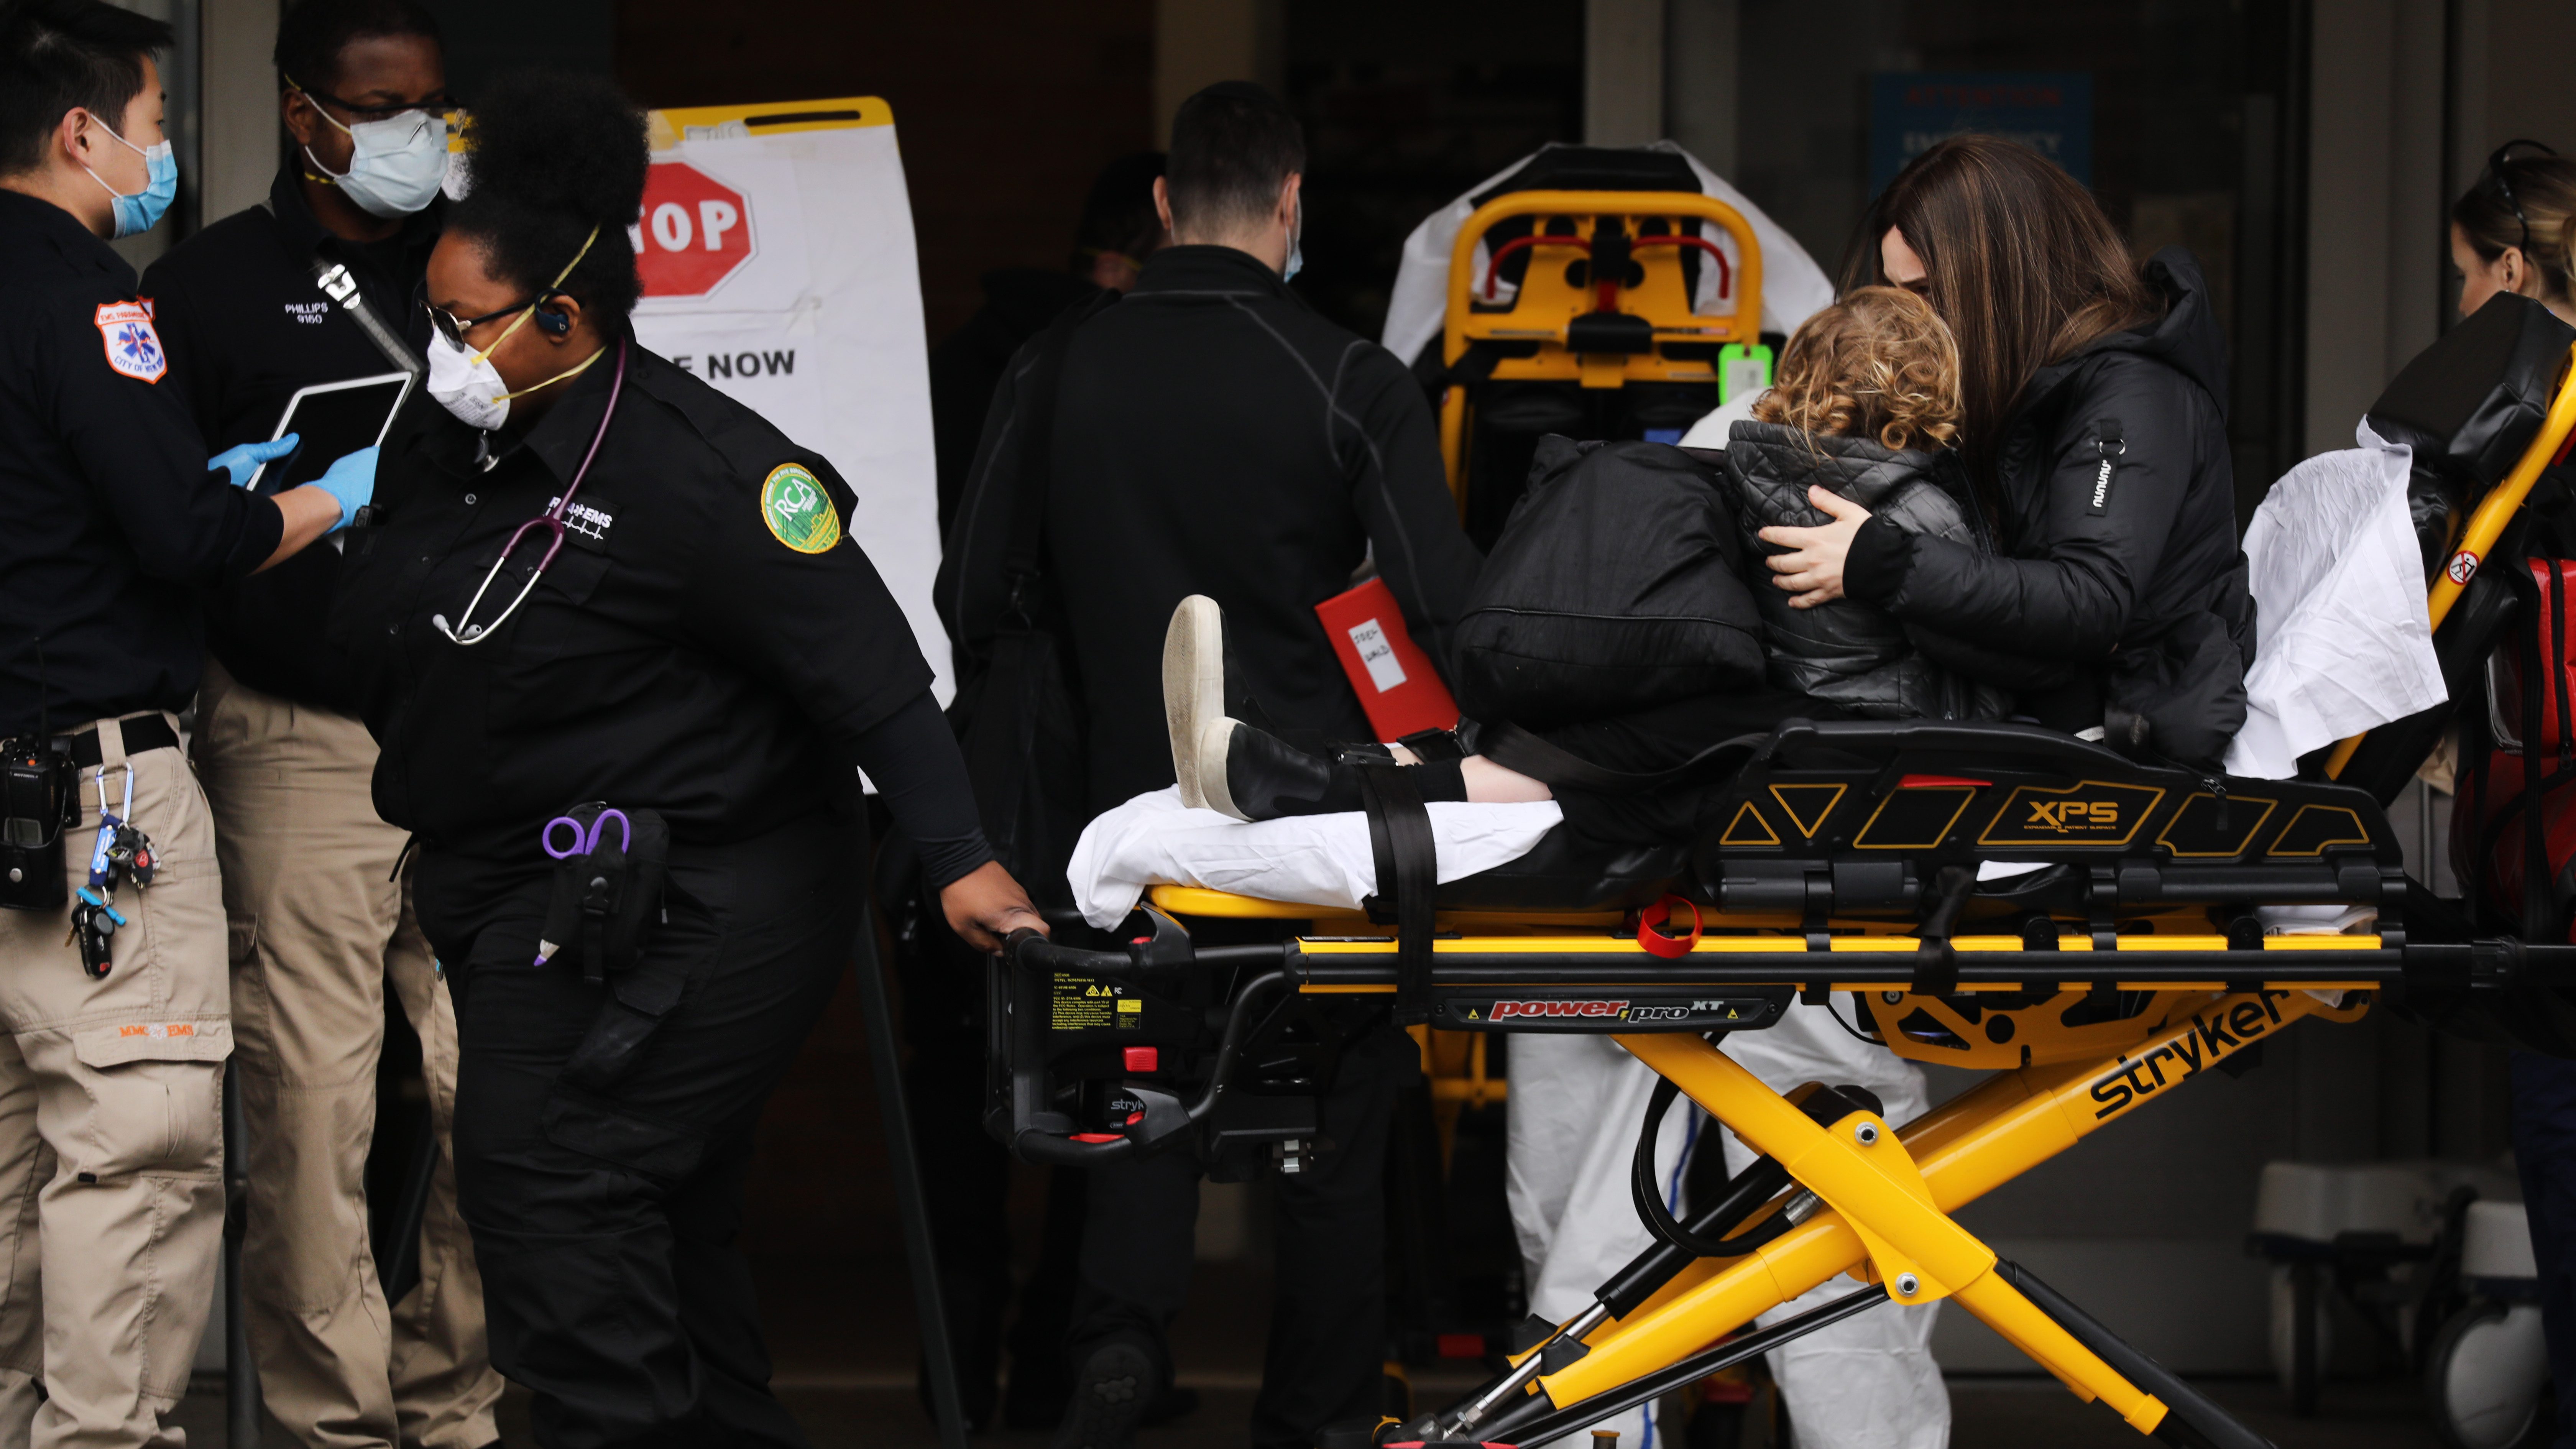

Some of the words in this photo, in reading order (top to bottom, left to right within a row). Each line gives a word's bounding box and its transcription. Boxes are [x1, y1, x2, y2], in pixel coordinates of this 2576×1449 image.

[285, 301, 328, 314] PHILLIPS
[115, 356, 133, 370] CITY
[708, 349, 795, 380] NOW
[774, 478, 813, 522] RCA
[2027, 801, 2119, 833] XPS
[1627, 1006, 1689, 1023] pro
[1691, 1000, 1724, 1011] XT
[2090, 989, 2290, 1120] stryker
